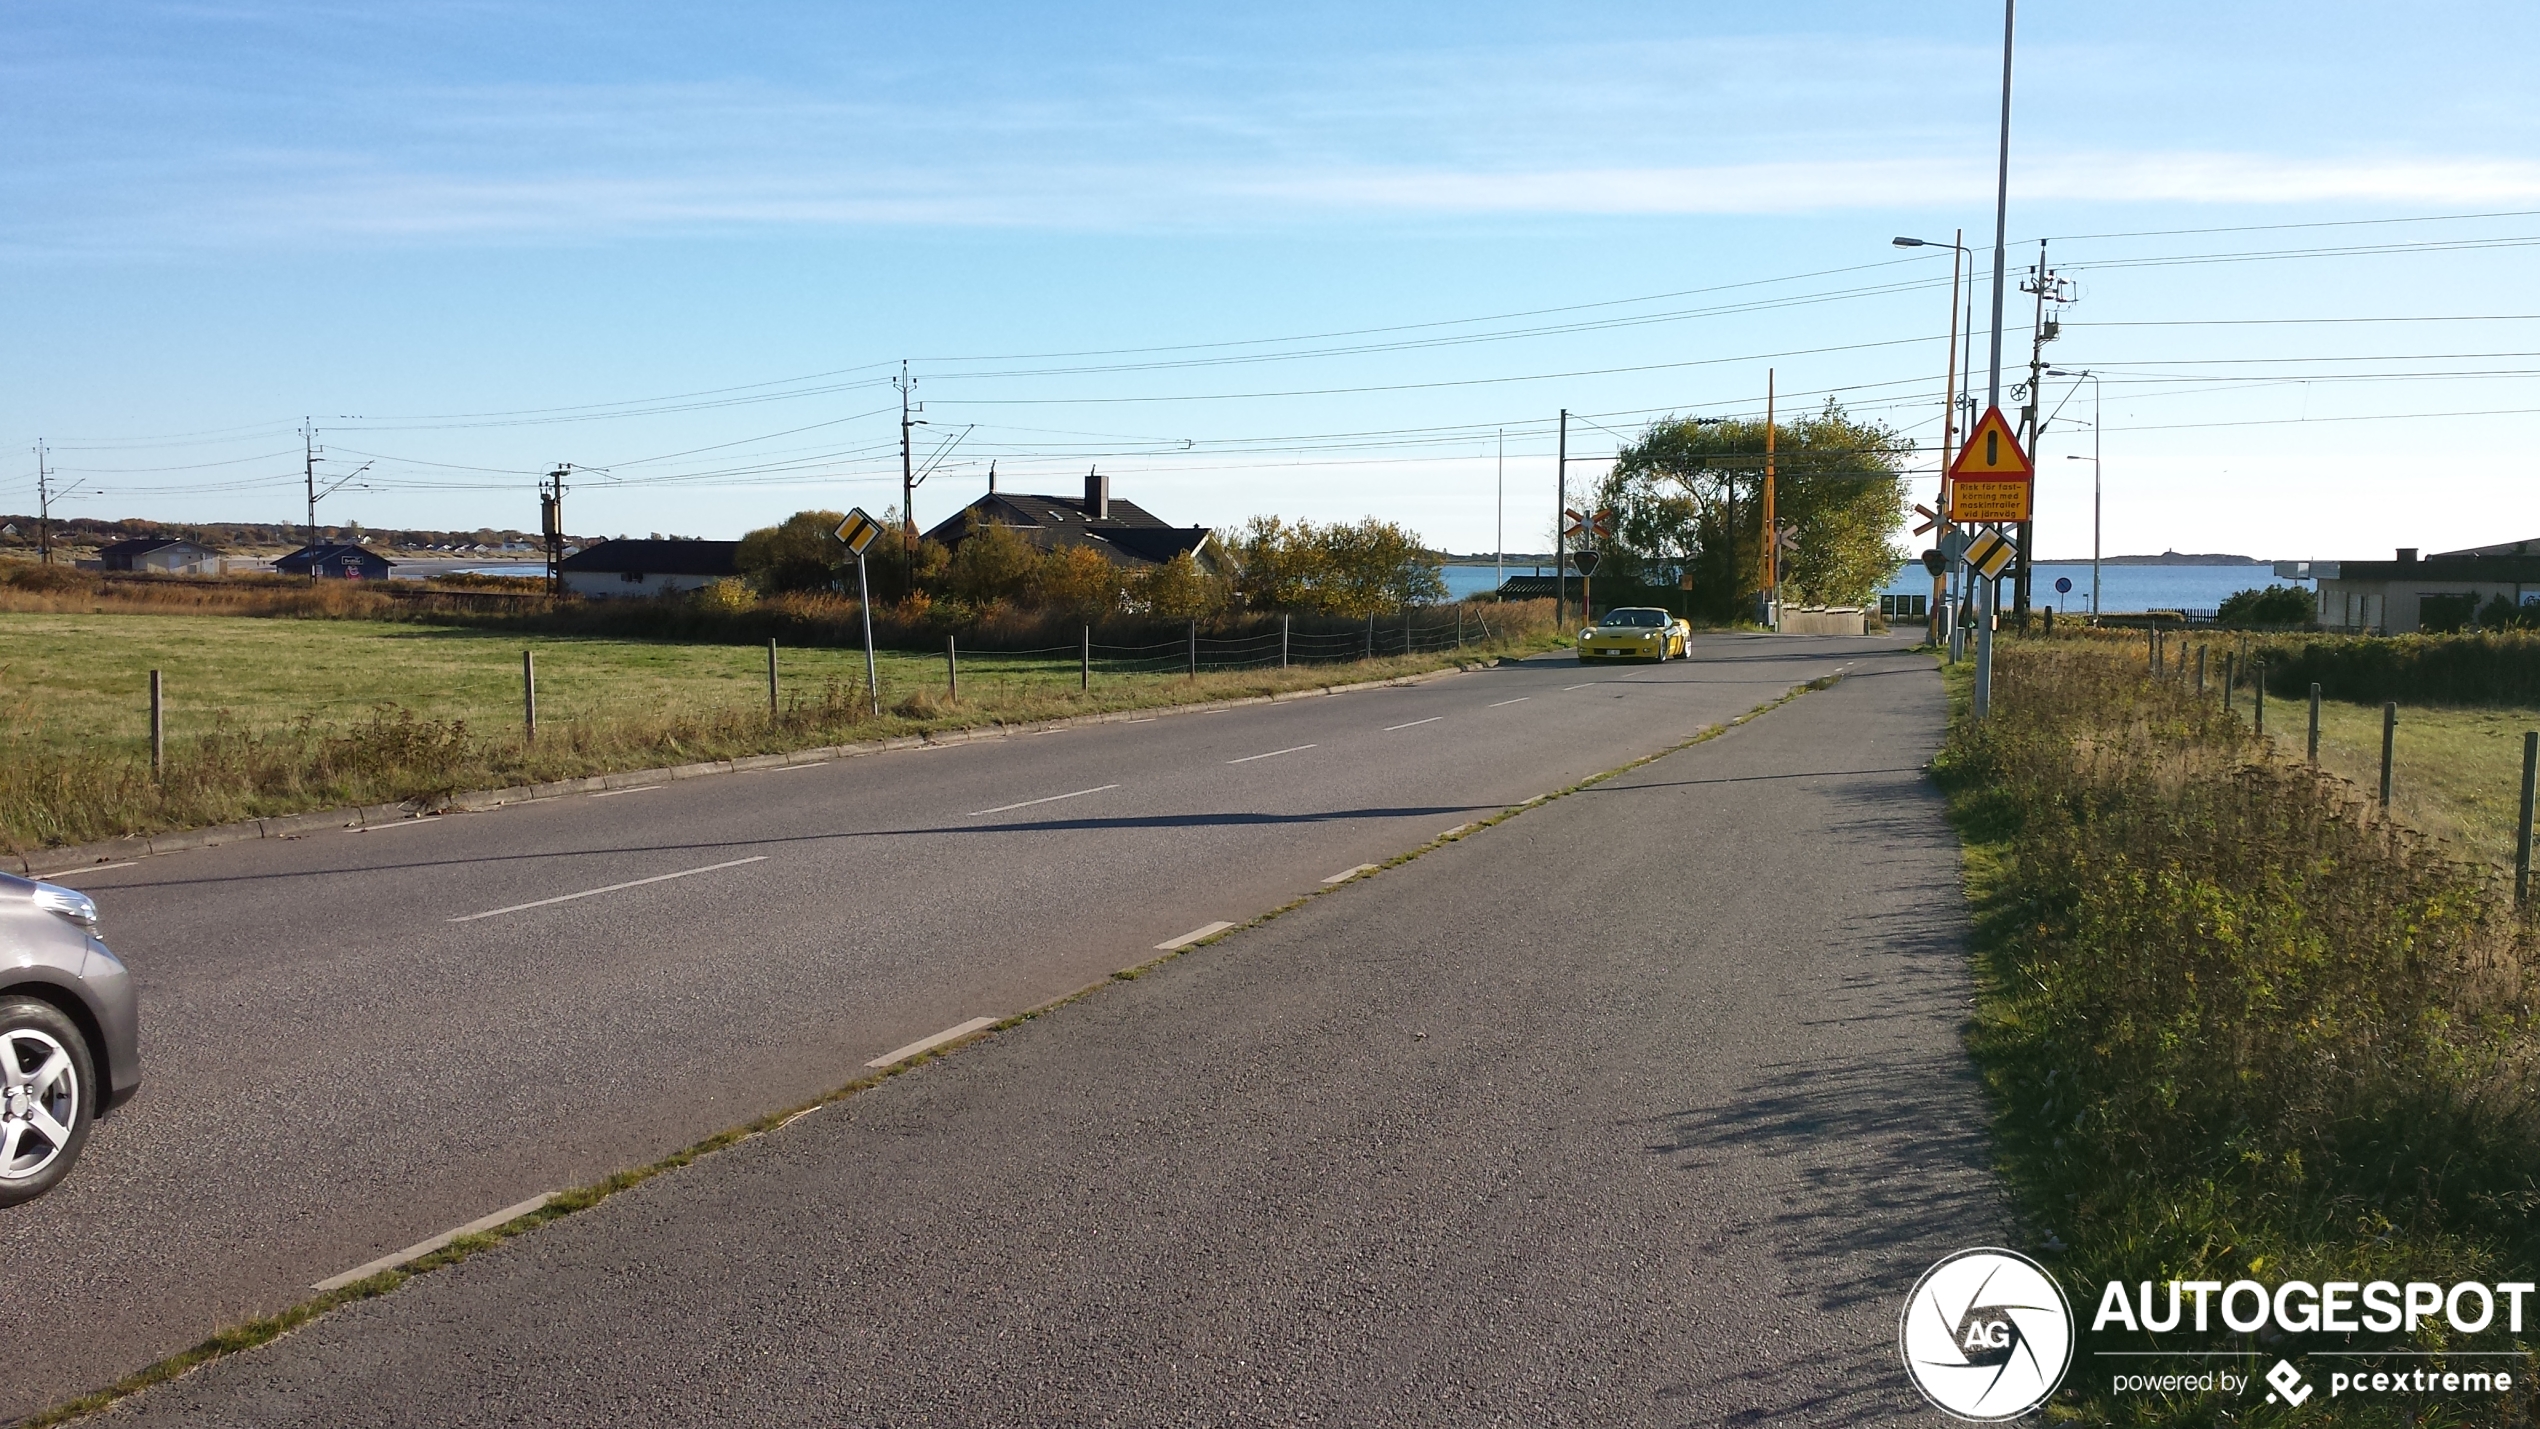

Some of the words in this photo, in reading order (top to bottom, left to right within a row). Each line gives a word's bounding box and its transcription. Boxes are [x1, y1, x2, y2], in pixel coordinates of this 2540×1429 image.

[1962, 493, 1997, 501] körning
[2000, 492, 2019, 500] med
[1960, 501, 2021, 509] maskintrailer
[1964, 510, 1978, 518] vid
[1981, 510, 2016, 519] järnväg
